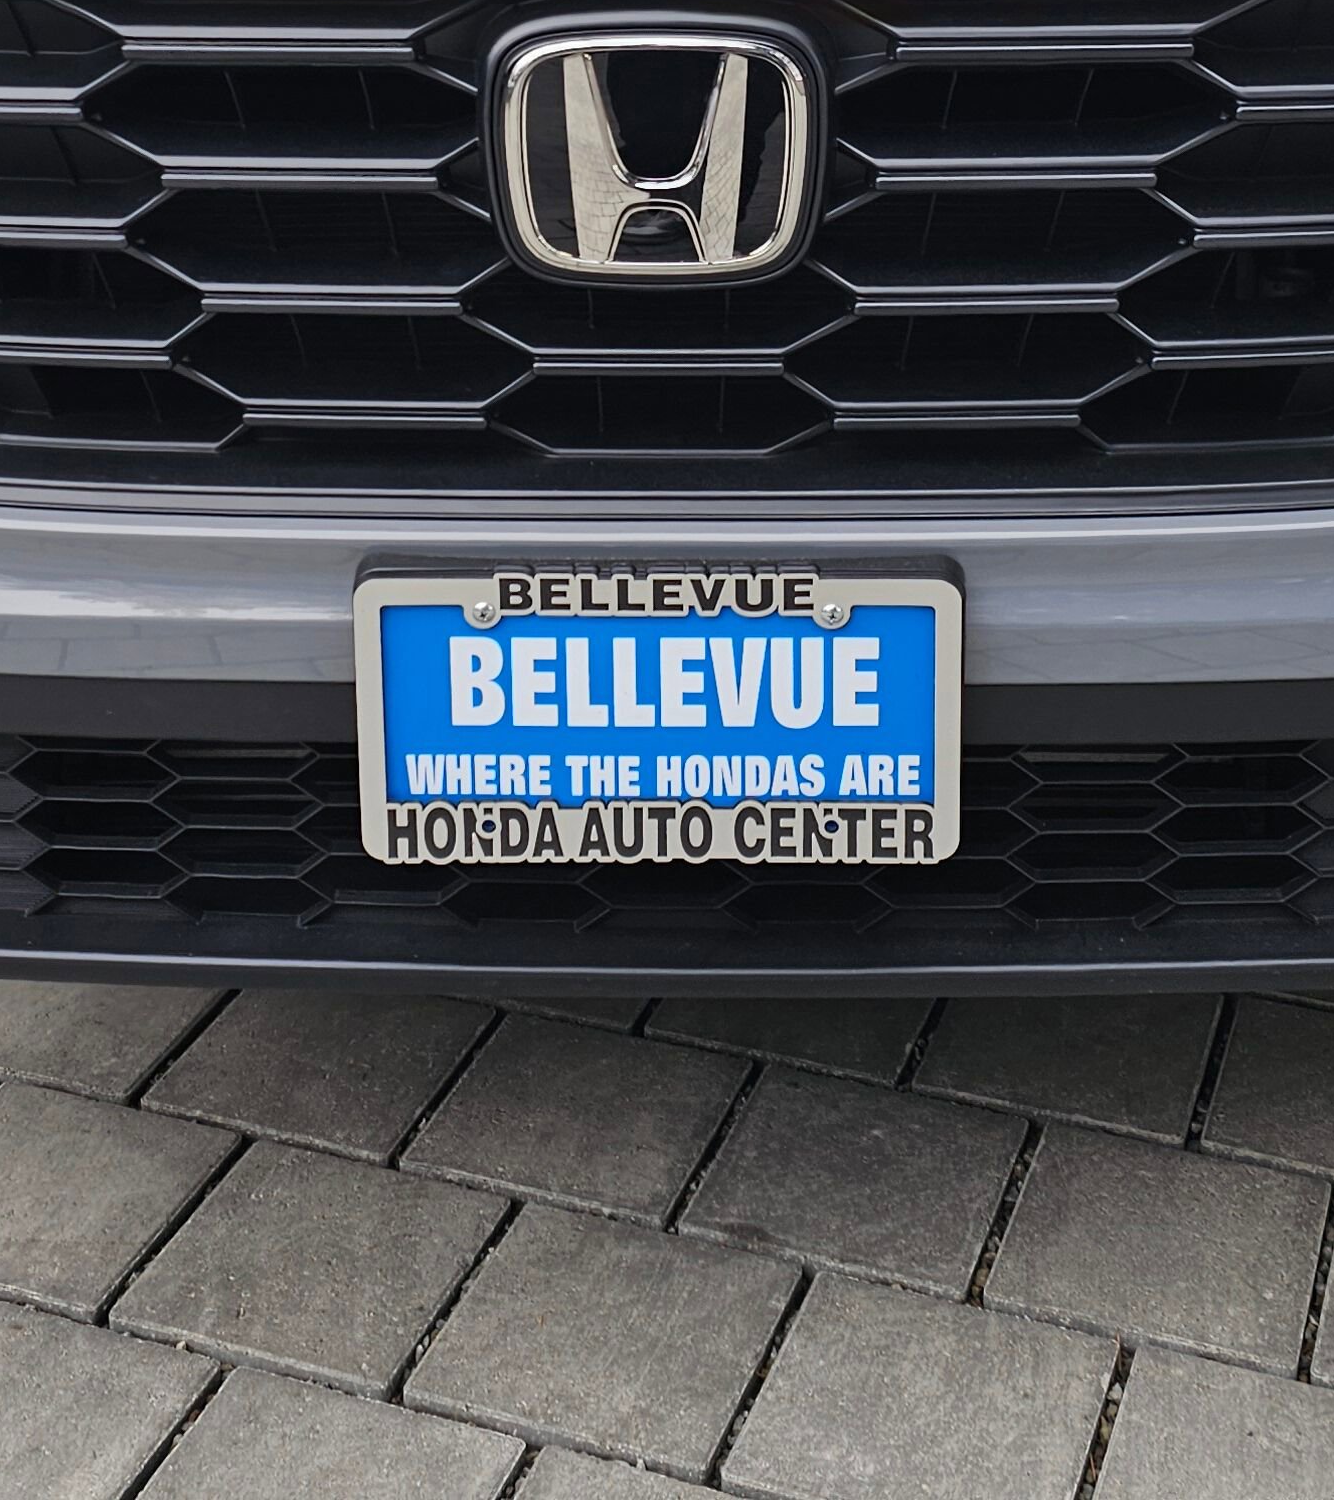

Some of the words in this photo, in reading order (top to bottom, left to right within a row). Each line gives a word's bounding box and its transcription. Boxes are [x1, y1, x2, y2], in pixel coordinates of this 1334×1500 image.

[498, 578, 815, 612] BELLEVUE
[449, 636, 880, 729] BELLEVUE
[405, 754, 552, 796] WHERE
[565, 755, 641, 797] THE
[656, 754, 826, 797] HONDAS
[838, 755, 920, 796] ARE
[386, 806, 564, 859] HONDA
[579, 806, 713, 858] AUTO
[733, 806, 934, 859] CENTER
